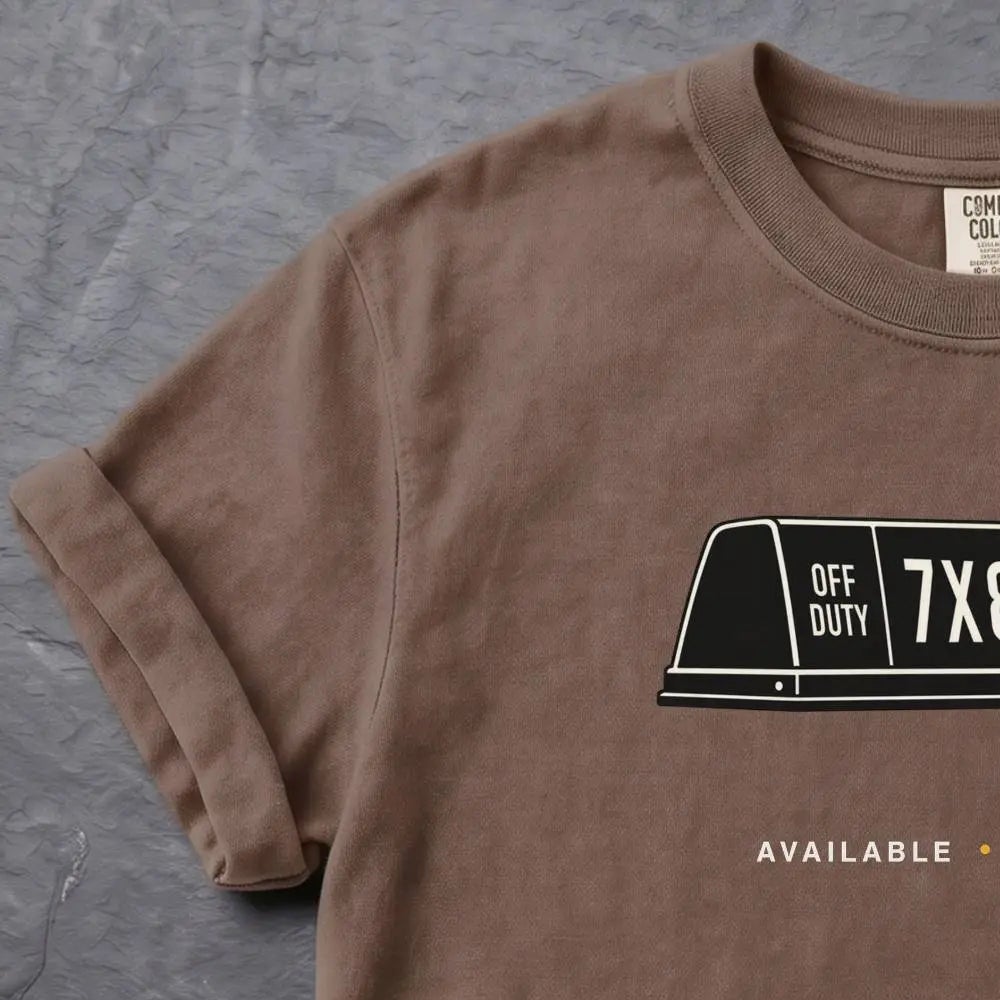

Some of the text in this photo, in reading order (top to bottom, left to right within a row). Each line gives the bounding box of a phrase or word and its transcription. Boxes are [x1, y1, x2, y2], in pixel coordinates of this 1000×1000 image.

[811, 563, 856, 597] OFF
[809, 603, 868, 637] DUTY
[756, 840, 952, 863] AVAILABLE
